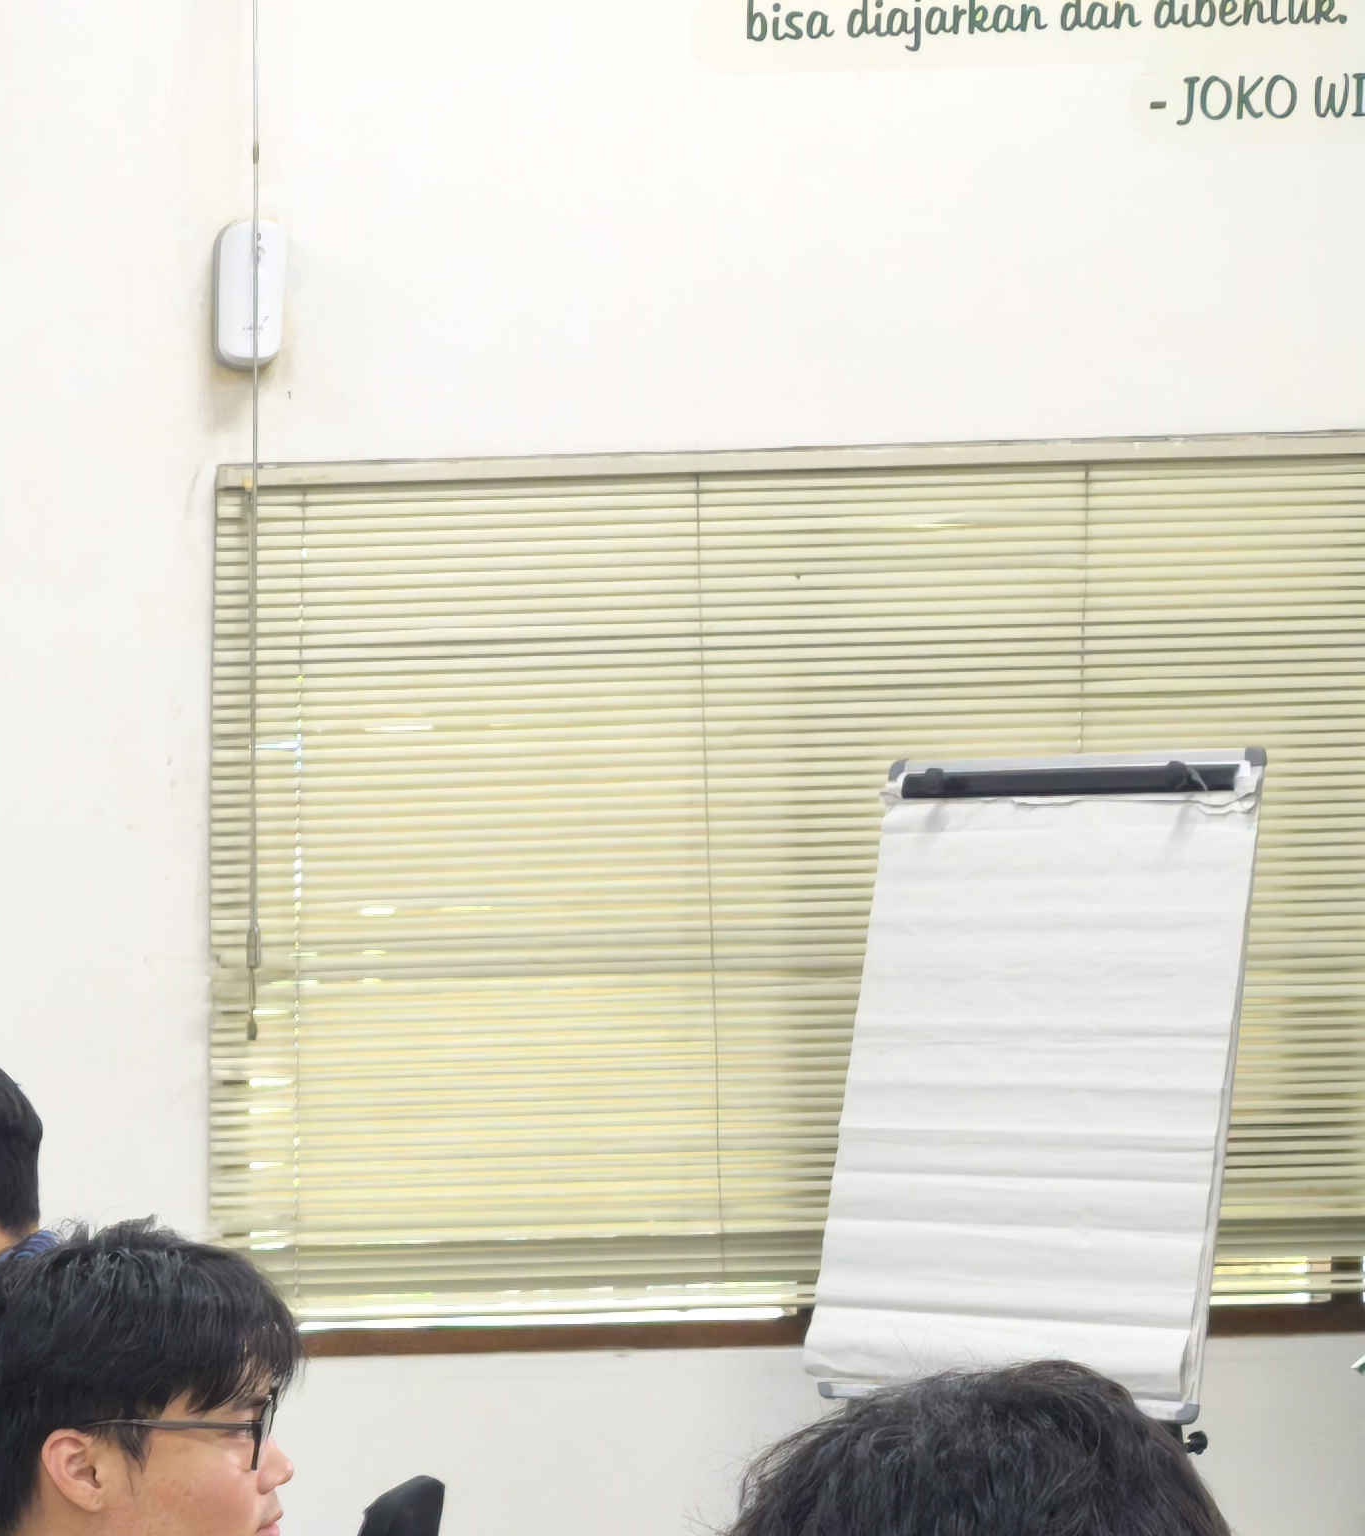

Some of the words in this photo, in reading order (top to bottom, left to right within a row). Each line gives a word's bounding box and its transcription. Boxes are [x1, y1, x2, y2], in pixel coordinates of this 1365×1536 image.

[746, 0, 835, 42] bisa
[847, 0, 1047, 52] diajarkan
[1176, 74, 1298, 126] JOKO
